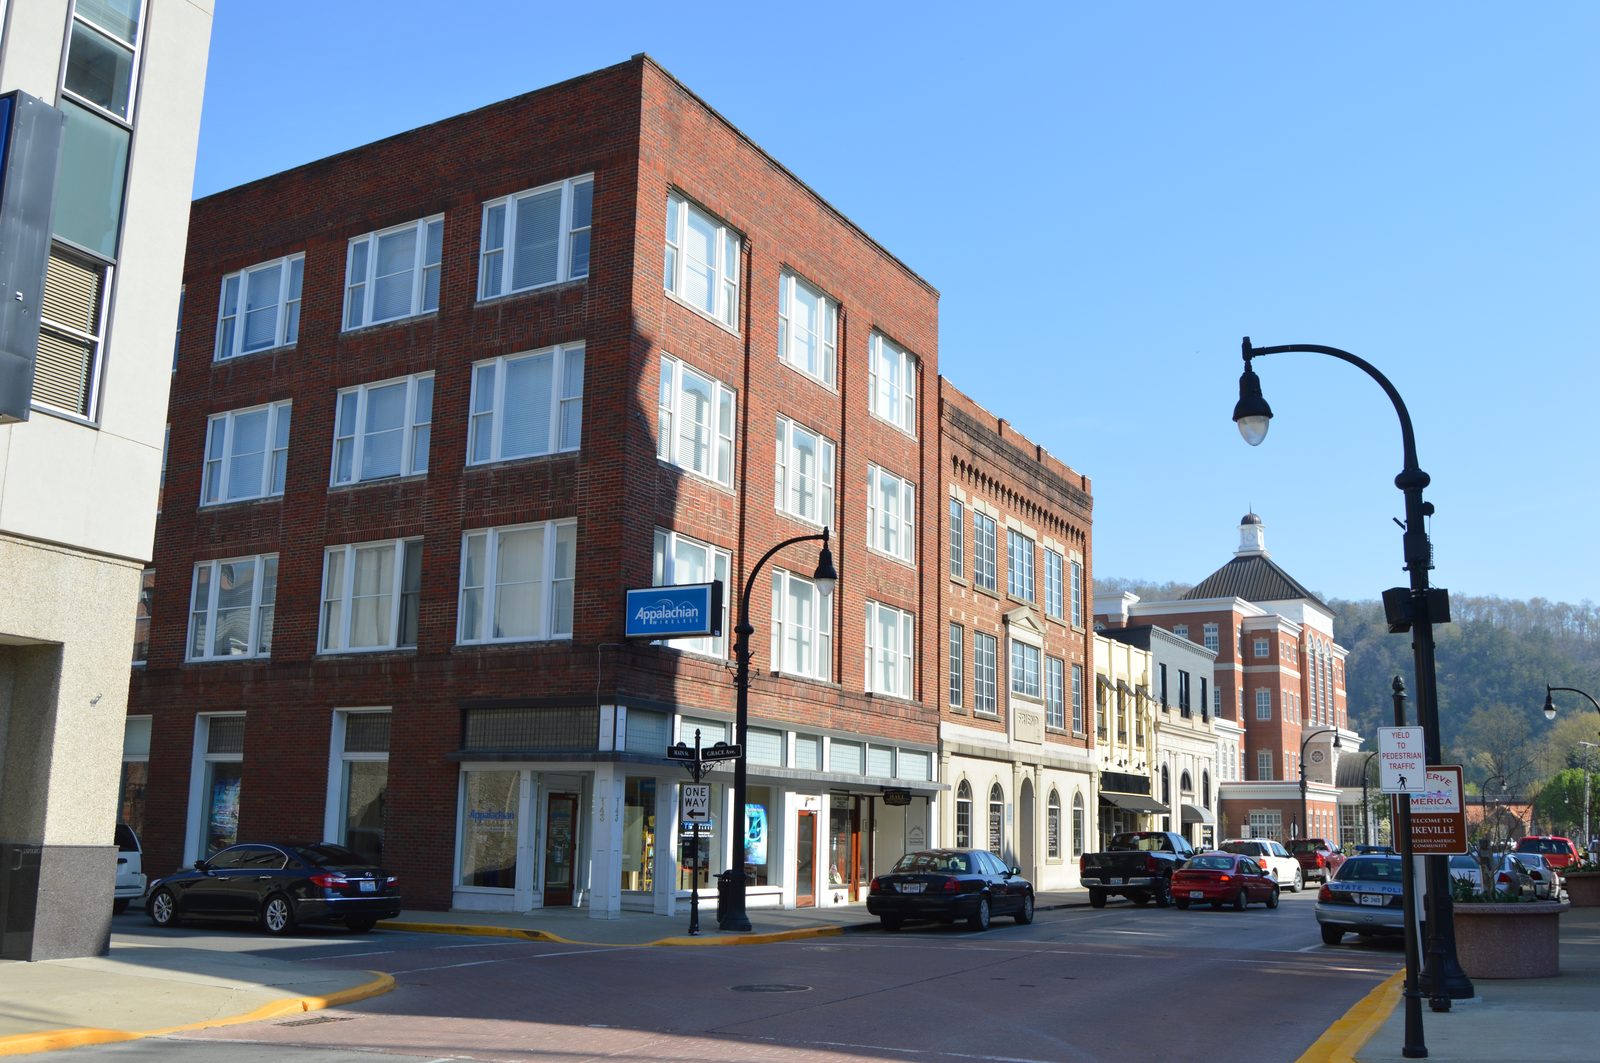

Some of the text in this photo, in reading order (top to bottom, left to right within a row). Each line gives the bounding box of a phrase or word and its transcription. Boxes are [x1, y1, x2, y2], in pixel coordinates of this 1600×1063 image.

[635, 605, 699, 625] Appalachian
[1391, 731, 1410, 739] YIELD
[1382, 752, 1422, 760] PEDESTRIAN
[1426, 773, 1453, 787] ERVE
[685, 787, 706, 797] ONE
[684, 798, 707, 807] WAY
[1412, 826, 1456, 834] IKEVILLE
